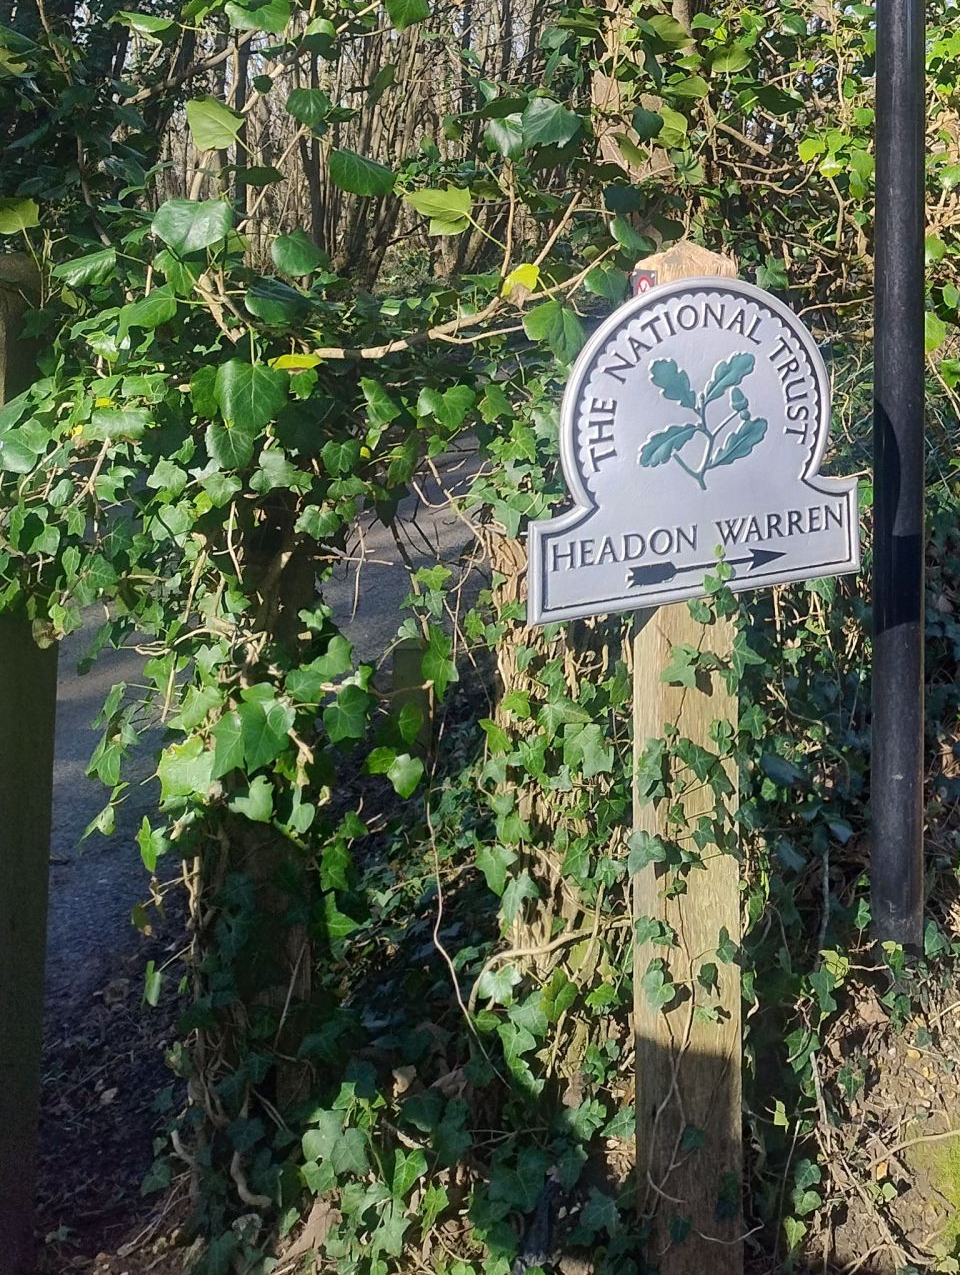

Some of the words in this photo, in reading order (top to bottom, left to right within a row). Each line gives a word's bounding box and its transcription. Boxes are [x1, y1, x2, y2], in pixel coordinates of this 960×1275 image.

[589, 397, 617, 473] THE
[604, 303, 763, 384] NATIONAL
[768, 336, 810, 445] TRUST
[552, 524, 699, 573] HEADON
[716, 503, 844, 546] WARREN
